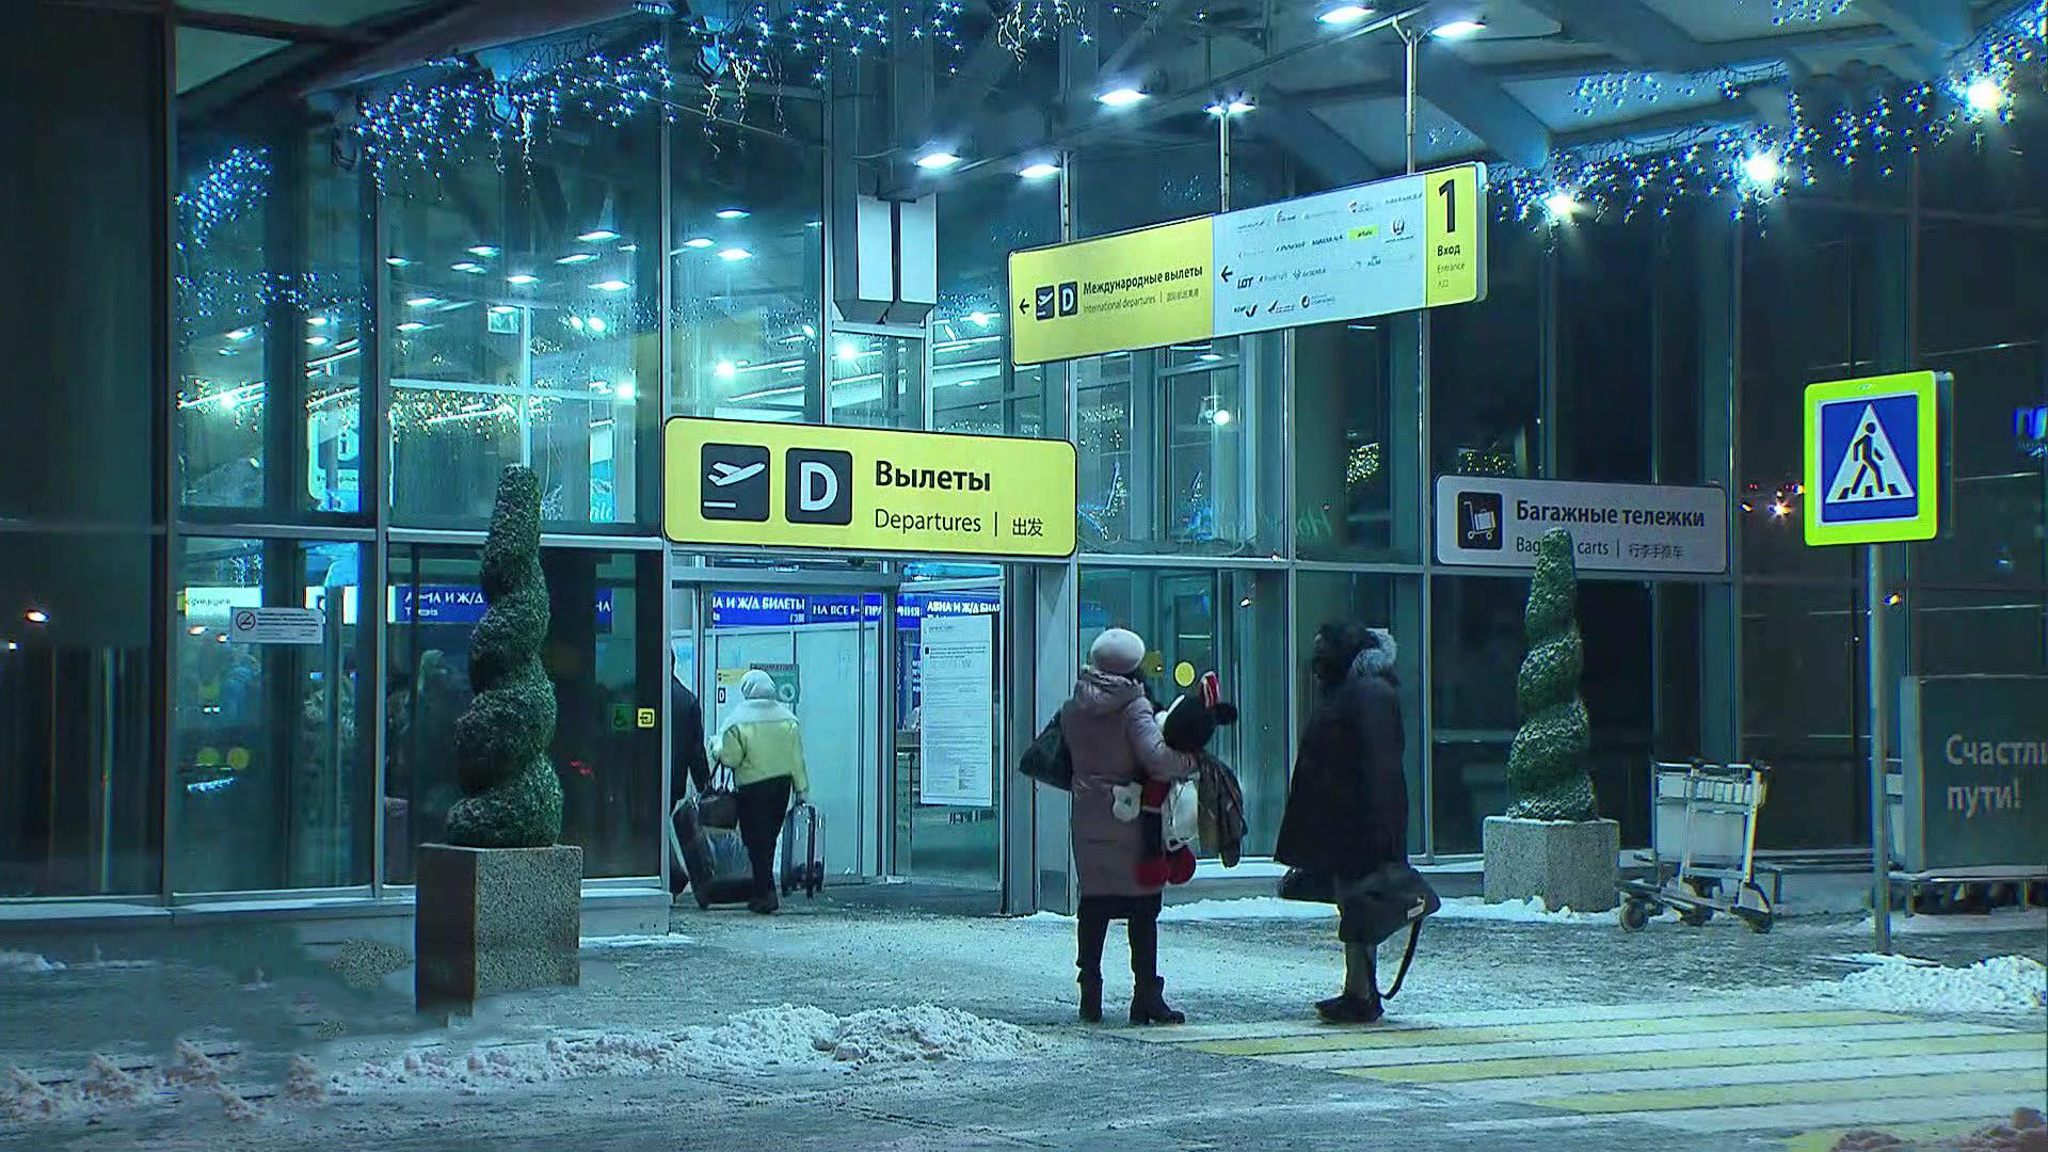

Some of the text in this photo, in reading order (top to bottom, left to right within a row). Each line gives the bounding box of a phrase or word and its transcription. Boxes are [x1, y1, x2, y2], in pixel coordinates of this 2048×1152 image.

[1439, 179, 1455, 233] 1
[1437, 245, 1461, 257] Вход
[1083, 272, 1163, 296] Международные
[1164, 265, 1203, 282] вылеты
[1237, 276, 1255, 290] LOT
[1061, 287, 1075, 312] D
[1083, 296, 1156, 315] International departures
[800, 462, 838, 512] D
[874, 460, 992, 492] Вылеты
[874, 508, 982, 534] Departures
[1516, 500, 1705, 527] Багажные тележки
[1577, 541, 1609, 556] carts
[762, 597, 806, 610] БИЛЕТЫ
[927, 601, 951, 613] АВИА
[1946, 777, 2021, 818] пути!
